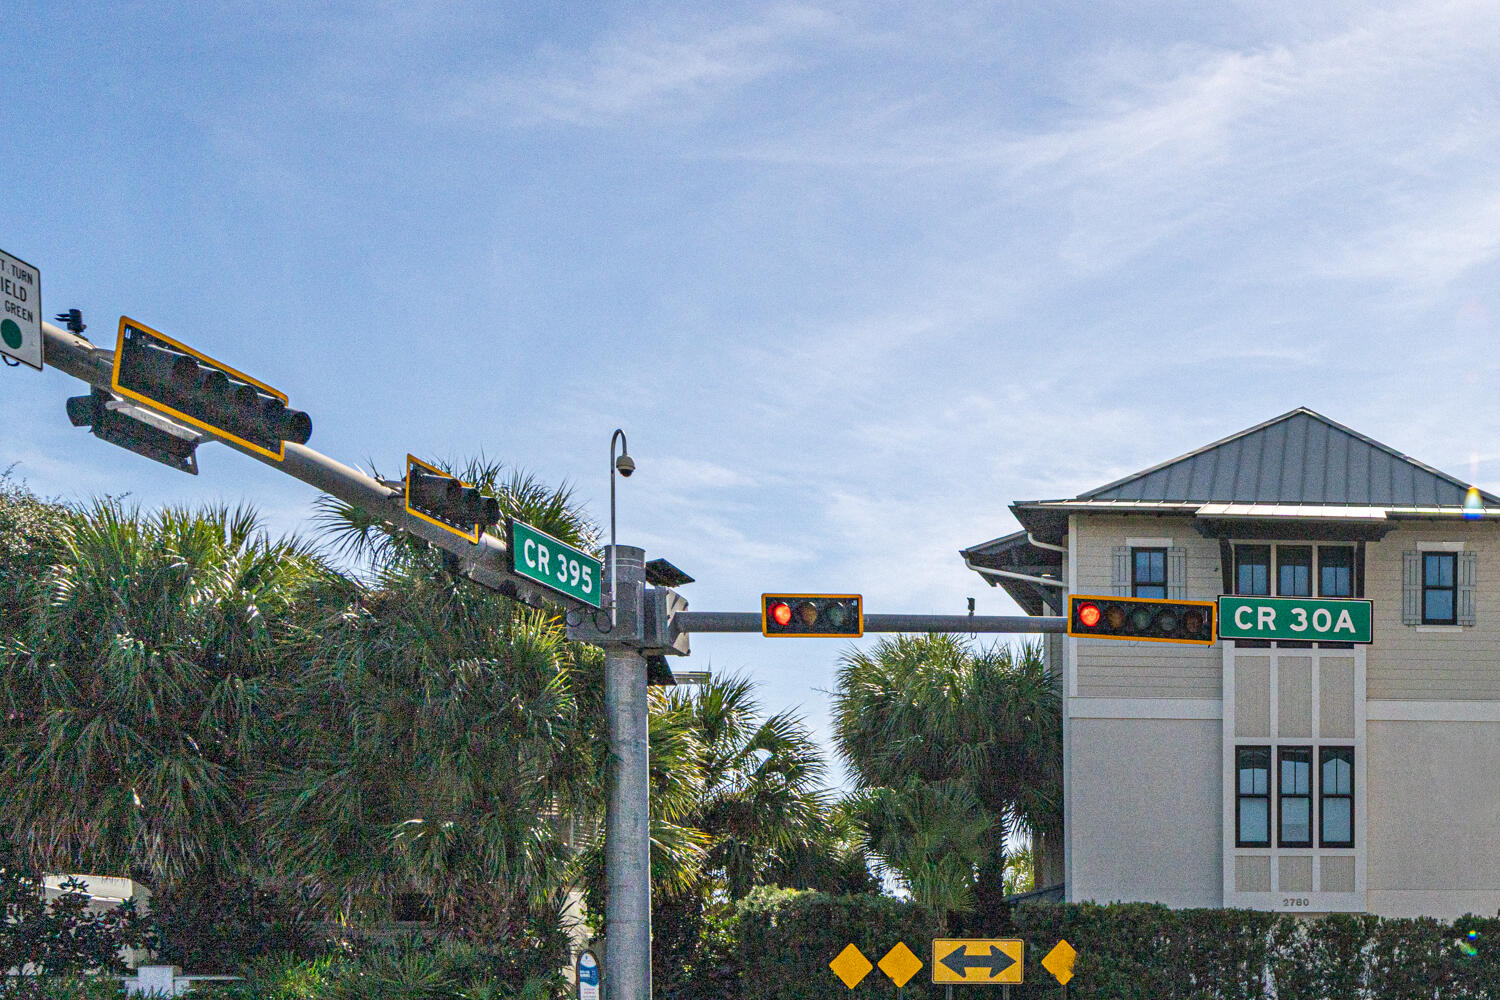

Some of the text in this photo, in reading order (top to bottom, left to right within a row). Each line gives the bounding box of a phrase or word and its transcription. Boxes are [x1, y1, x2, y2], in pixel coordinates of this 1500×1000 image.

[11, 264, 33, 285] TURN
[0, 276, 27, 302] IELD
[5, 300, 33, 323] GREEN
[524, 538, 592, 594] CR 395
[1234, 605, 1356, 634] CR 30A
[1282, 898, 1310, 907] 2780
